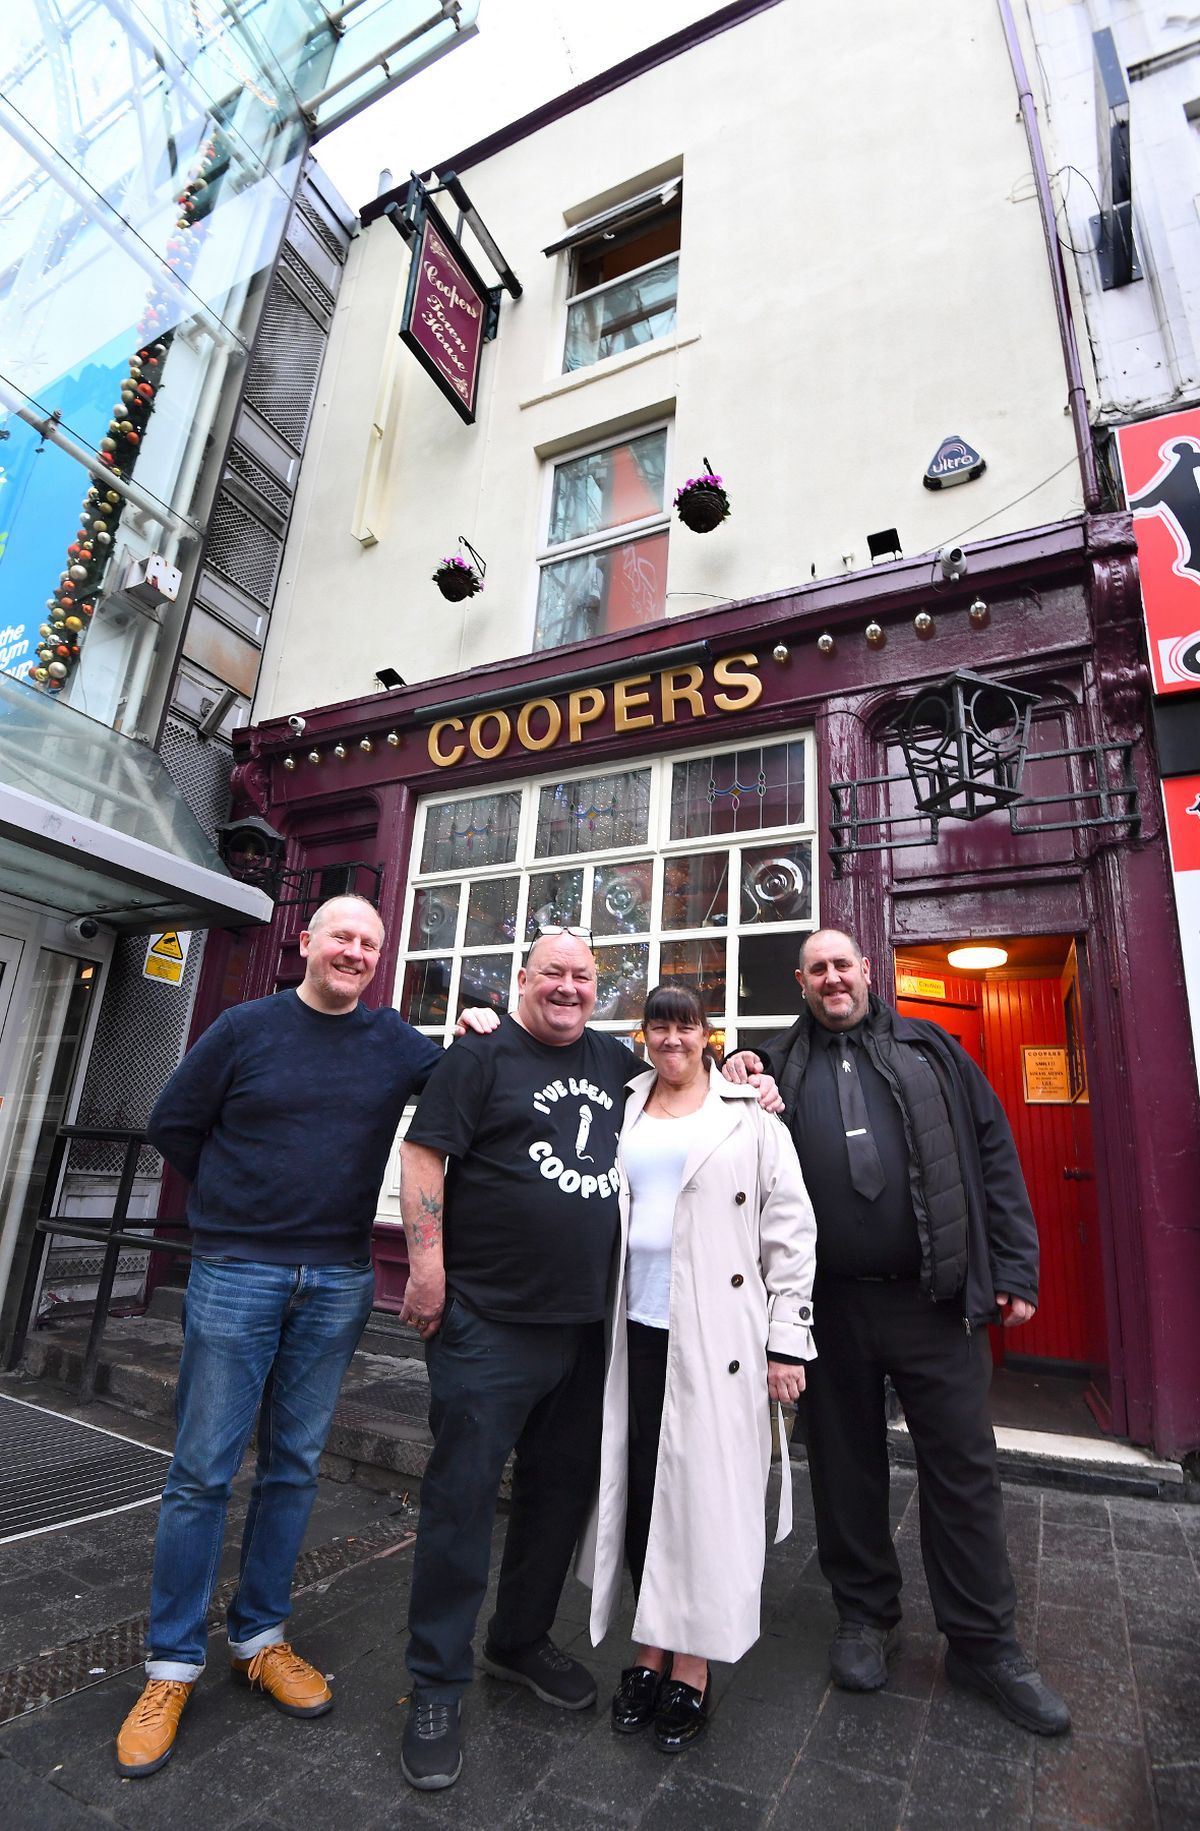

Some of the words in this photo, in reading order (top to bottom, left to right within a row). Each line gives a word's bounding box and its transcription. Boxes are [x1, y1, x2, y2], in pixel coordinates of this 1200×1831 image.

[423, 260, 479, 320] Coopers
[421, 310, 468, 373] House
[427, 294, 468, 353] Town
[932, 455, 973, 473] ultra
[0, 639, 29, 671] ym
[427, 652, 763, 767] COOPERS
[533, 1079, 568, 1115] I'VE
[568, 1077, 614, 1111] BEEN
[528, 1140, 621, 1199] COOPER
